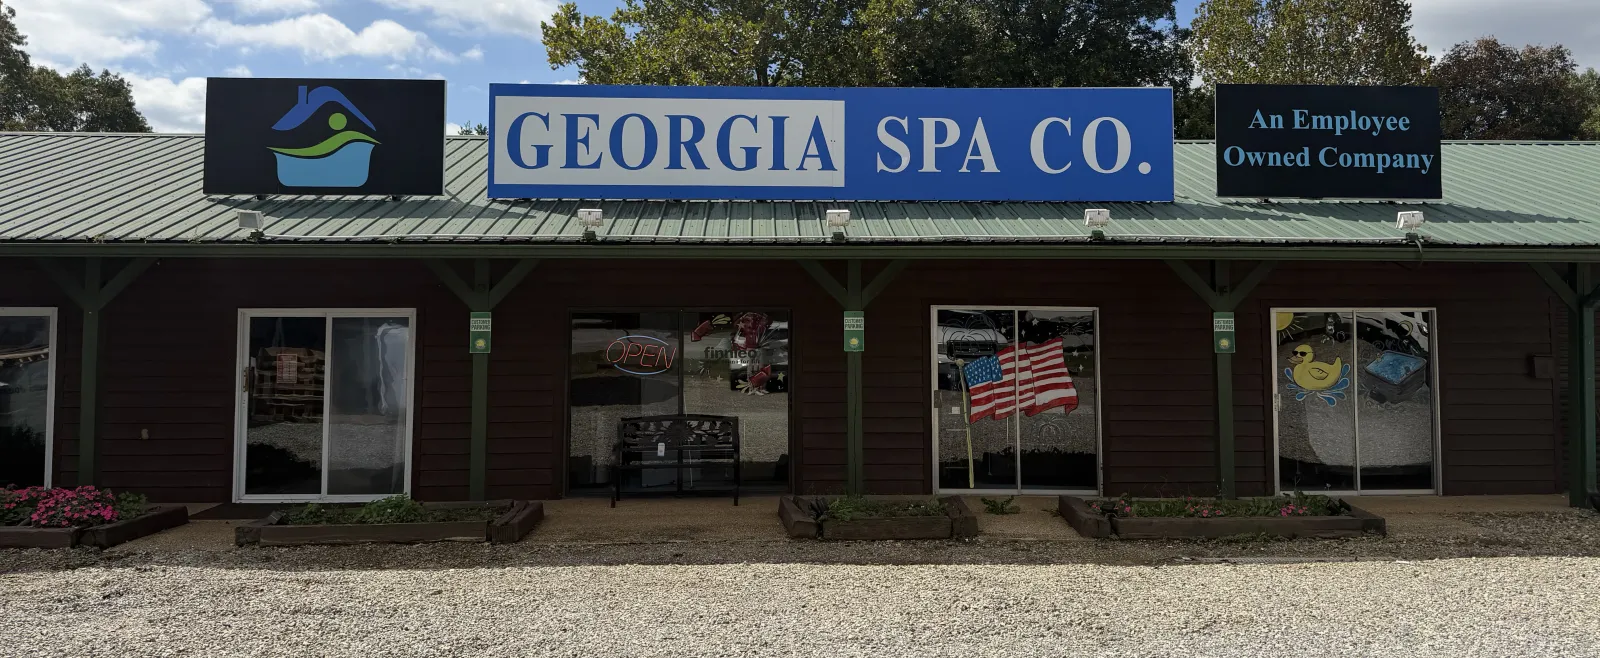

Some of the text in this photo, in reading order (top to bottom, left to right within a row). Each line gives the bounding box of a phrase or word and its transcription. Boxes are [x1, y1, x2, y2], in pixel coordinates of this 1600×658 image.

[1247, 109, 1410, 136] An Employee
[507, 111, 1152, 175] GEORGIA SPA CO.
[1223, 145, 1434, 174] Owned Company
[606, 340, 677, 369] OPEN
